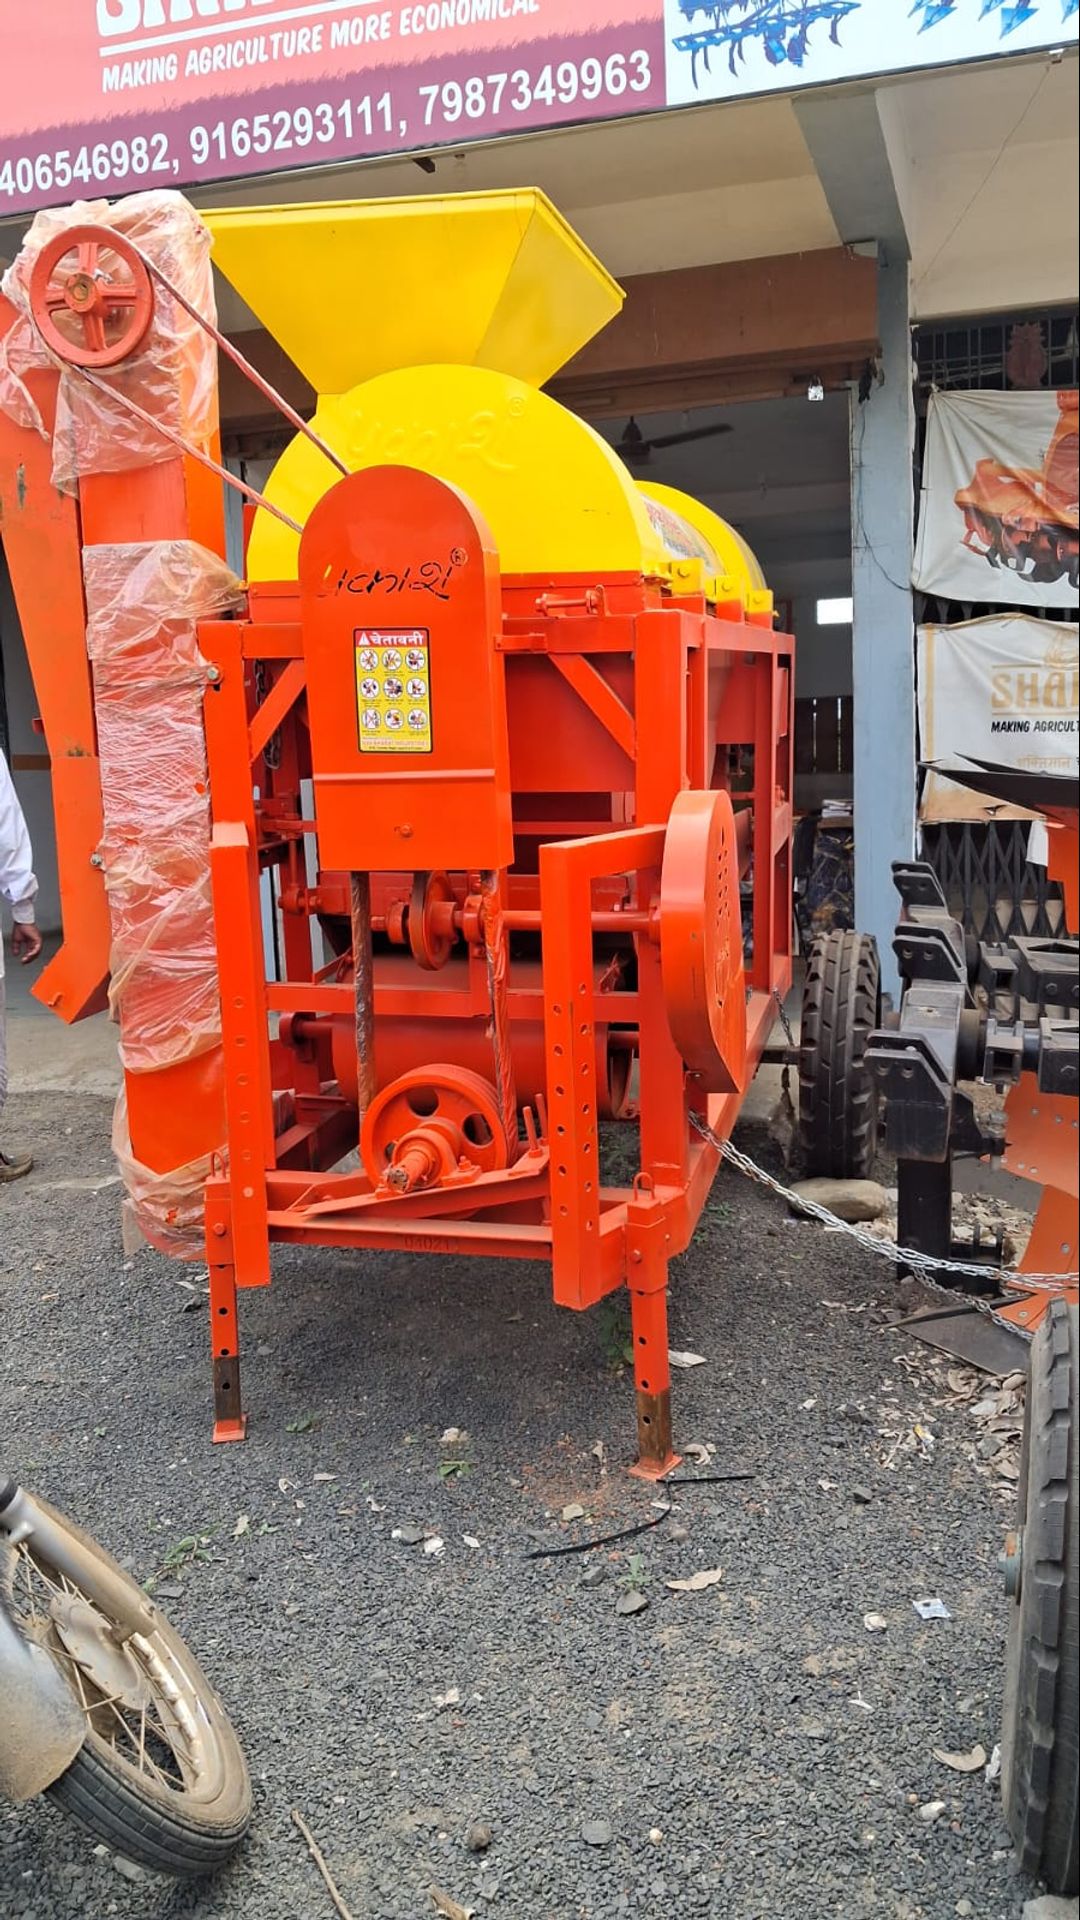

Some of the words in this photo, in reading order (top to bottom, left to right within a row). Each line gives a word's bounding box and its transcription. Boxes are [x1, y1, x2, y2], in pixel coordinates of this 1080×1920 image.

[101, 53, 178, 93] MAKING
[184, 24, 324, 77] AGRICULTURE
[330, 12, 392, 49] MORE
[0, 133, 180, 197] 406546982,
[189, 92, 407, 164] 9165293111,
[419, 49, 651, 126] 7987349963
[991, 720, 1030, 734] MAKING
